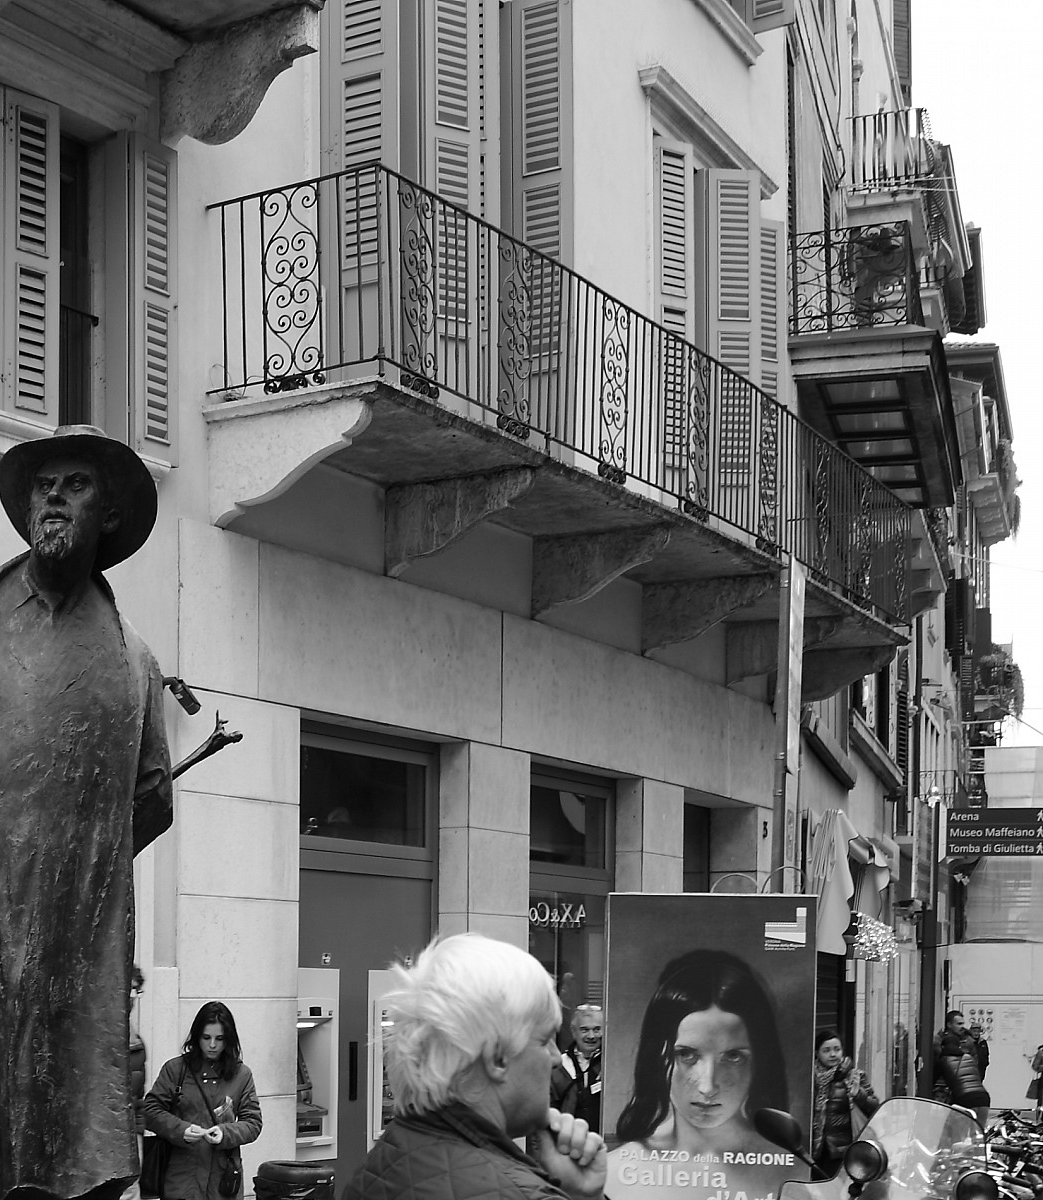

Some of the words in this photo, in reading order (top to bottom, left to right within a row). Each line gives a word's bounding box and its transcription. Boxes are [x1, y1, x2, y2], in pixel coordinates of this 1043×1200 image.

[949, 812, 980, 821] Arena
[762, 820, 768, 839] 3
[949, 828, 983, 837] Museo
[985, 827, 1035, 837] Maffeiano
[949, 844, 980, 853] Tomba
[982, 843, 992, 853] di
[993, 843, 1035, 853] Giulietta
[619, 1149, 690, 1163] PALAZZO
[693, 1152, 720, 1164] della
[723, 1151, 795, 1166] RAGIONE
[617, 1162, 728, 1189] Galleria
